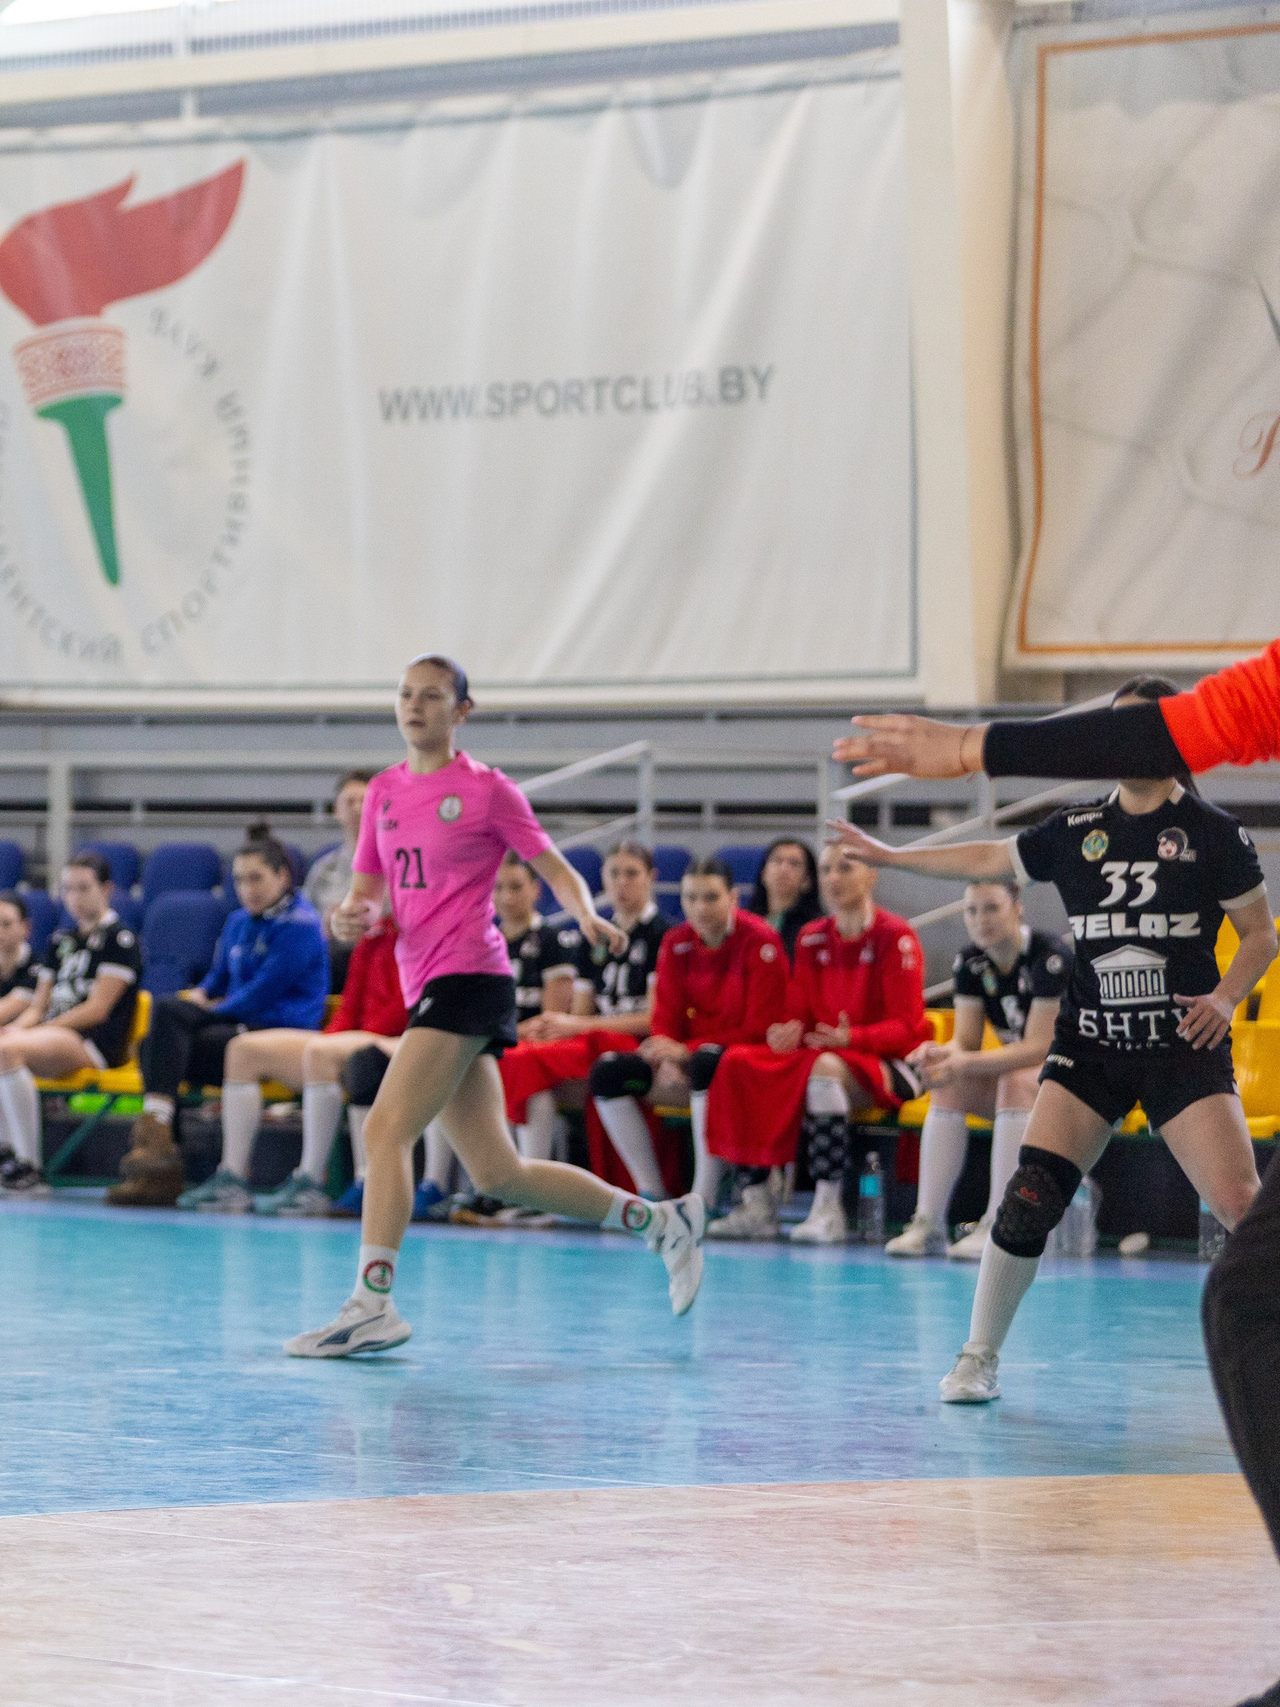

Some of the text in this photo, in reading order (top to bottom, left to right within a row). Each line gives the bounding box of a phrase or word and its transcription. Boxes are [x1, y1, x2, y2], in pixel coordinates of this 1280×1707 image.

[379, 364, 774, 424] WWW.SPORTCLUB.BY
[395, 847, 428, 890] 21
[1098, 861, 1159, 908] 33
